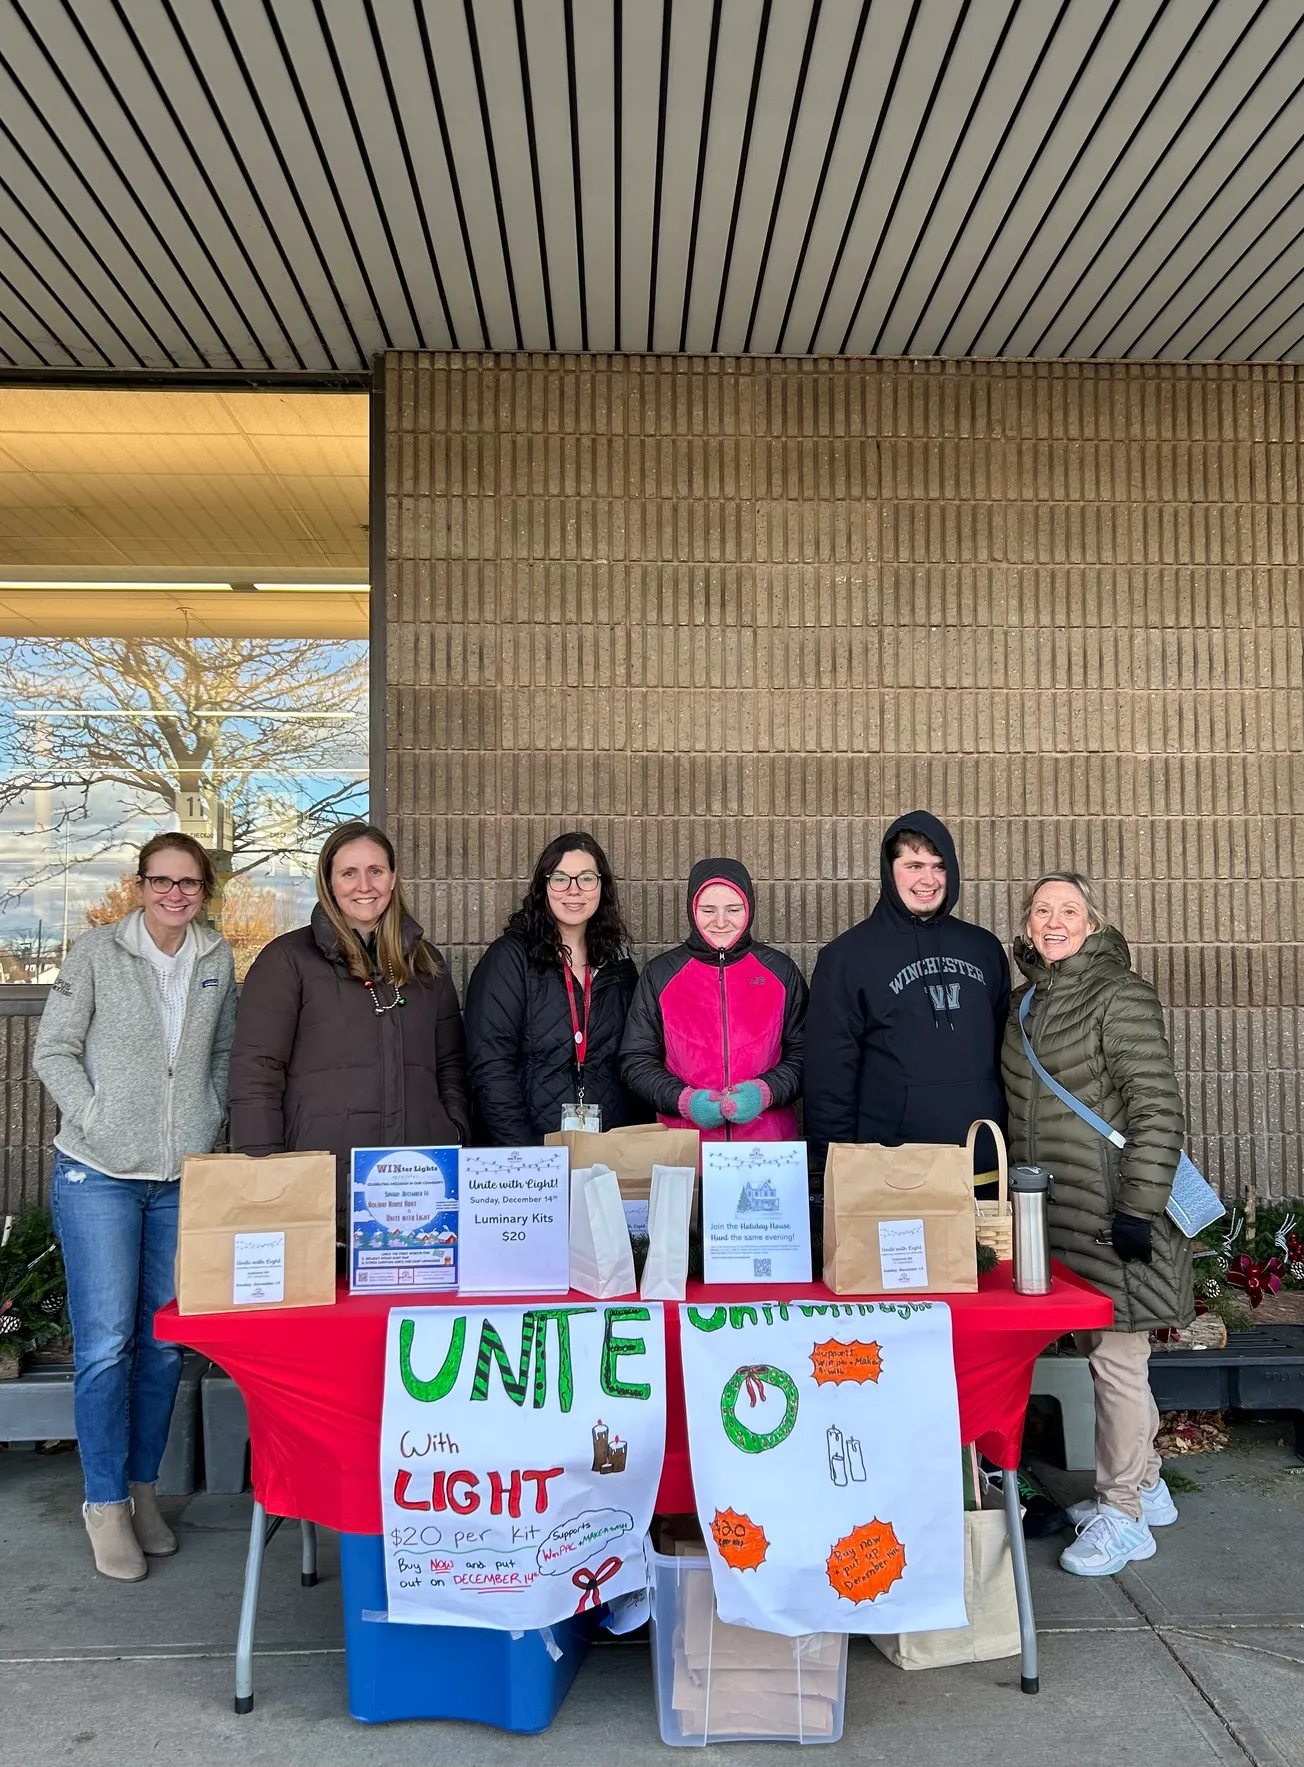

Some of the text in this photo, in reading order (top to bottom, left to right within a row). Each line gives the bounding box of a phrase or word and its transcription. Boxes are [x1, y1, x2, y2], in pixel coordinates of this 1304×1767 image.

[889, 956, 987, 995] WINCHESTER
[924, 982, 961, 1011] W
[414, 1165, 438, 1173] Lights
[468, 1178, 559, 1192] Unite with Light!
[470, 1196, 500, 1205] Sunday,
[502, 1195, 541, 1204] December
[474, 1212, 554, 1226] Luminary Kits
[710, 1222, 791, 1232] Join the Holiday House
[502, 1230, 526, 1242] $20
[730, 1233, 743, 1241] the
[765, 1233, 795, 1242] evening!
[399, 1306, 652, 1413] UNITE
[400, 1430, 460, 1459] With
[393, 1466, 565, 1519] LIGHT
[391, 1525, 442, 1548] $20
[454, 1528, 492, 1549] per
[552, 1521, 592, 1541] Supports
[834, 1535, 881, 1562] Buy now
[398, 1557, 422, 1574] Buy
[466, 1559, 486, 1569] and
[495, 1559, 516, 1571] put
[843, 1558, 860, 1577] put
[865, 1548, 879, 1560] up
[400, 1577, 422, 1588] out
[430, 1578, 445, 1588] on
[453, 1573, 521, 1586] DECEMBER
